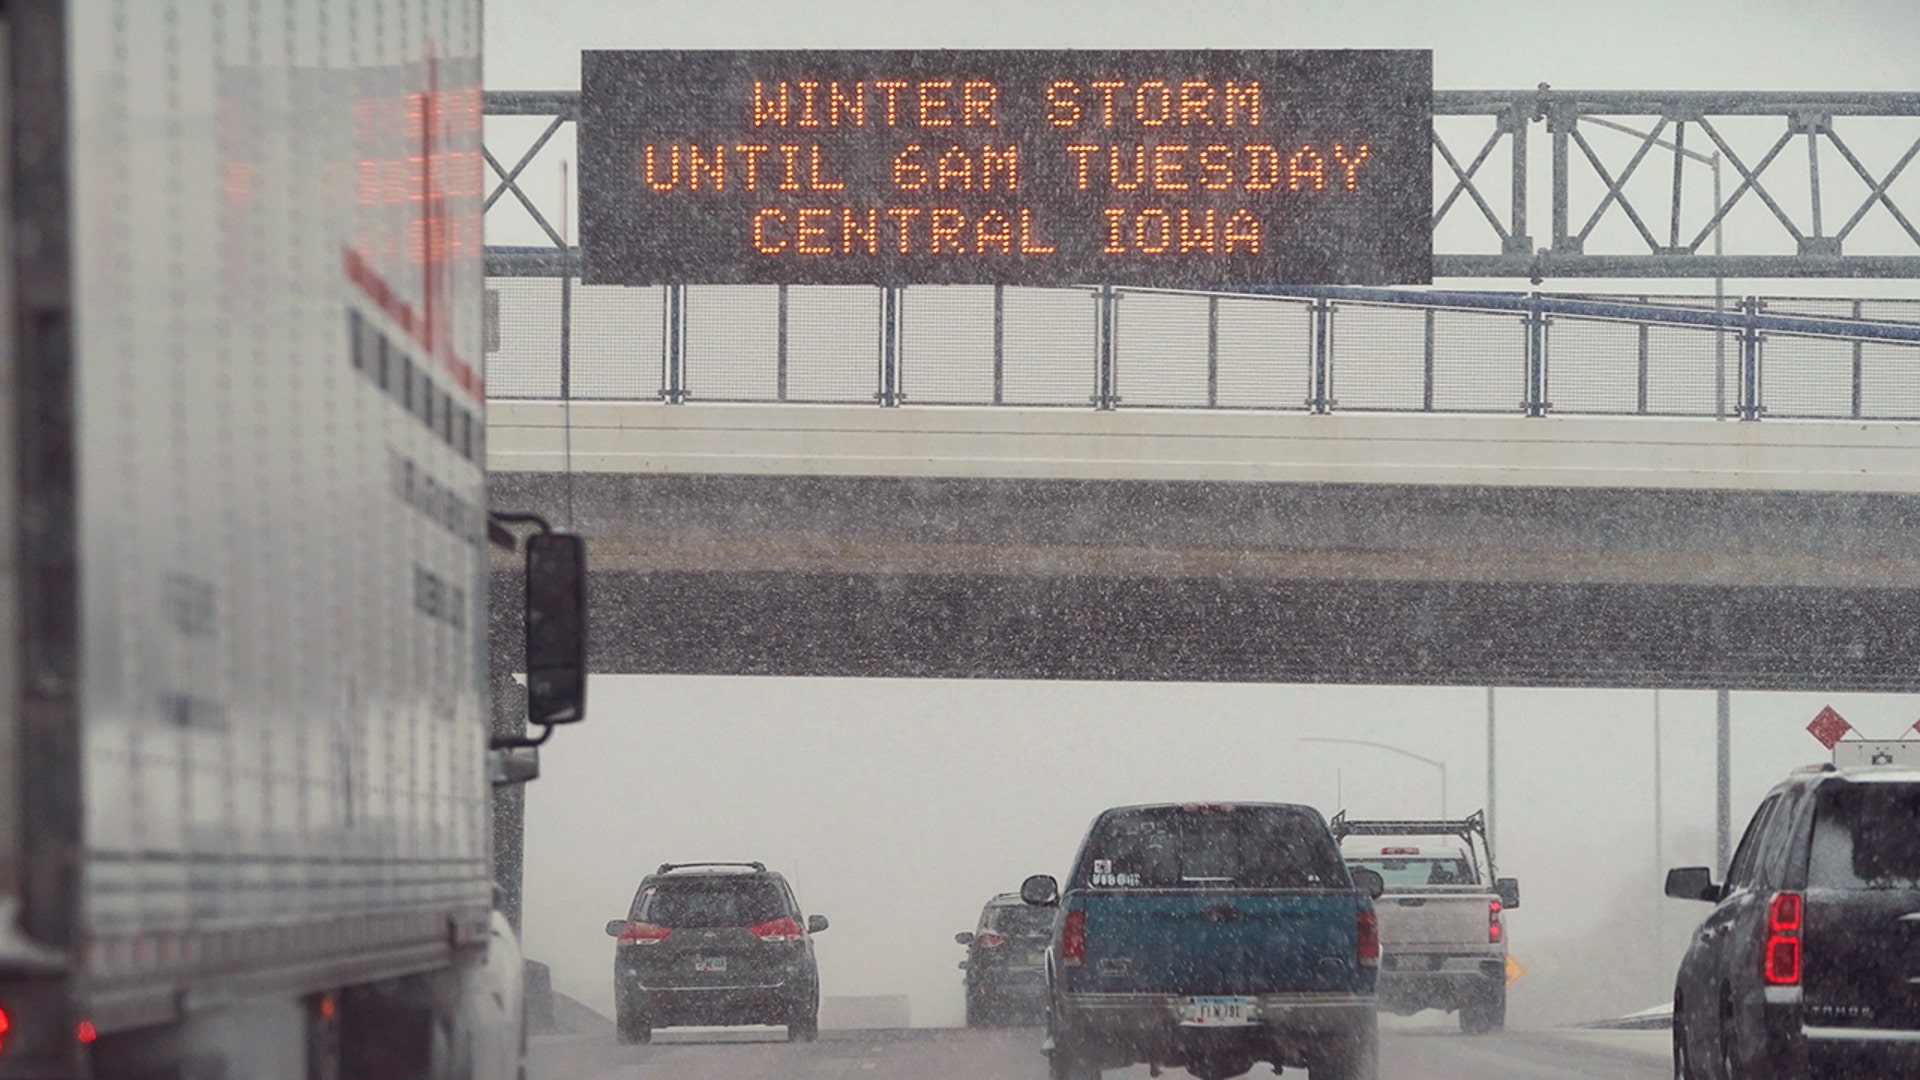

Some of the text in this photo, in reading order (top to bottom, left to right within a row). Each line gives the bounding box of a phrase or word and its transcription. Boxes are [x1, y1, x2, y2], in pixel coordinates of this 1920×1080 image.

[754, 81, 1260, 126] WINTER STORM
[646, 145, 1367, 191] UNTIL 6AM TUESDAY
[754, 208, 1259, 254] CENTRAL IOWA
